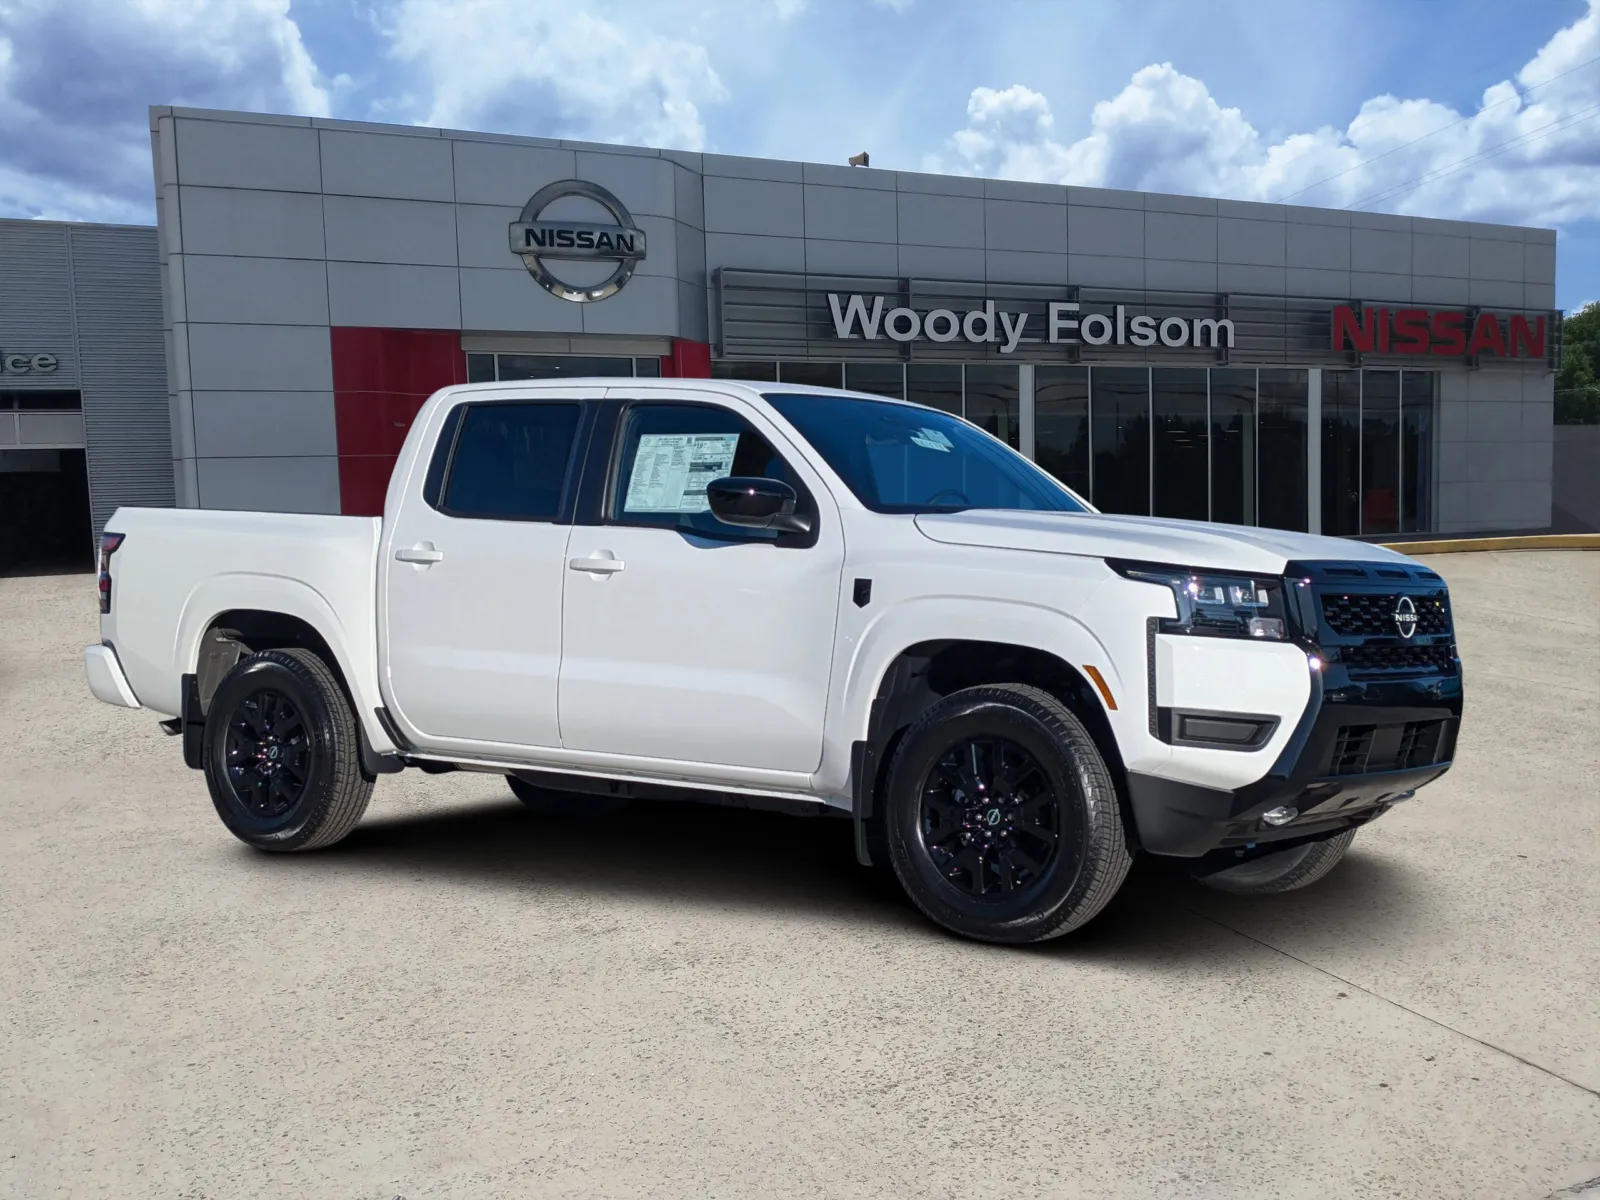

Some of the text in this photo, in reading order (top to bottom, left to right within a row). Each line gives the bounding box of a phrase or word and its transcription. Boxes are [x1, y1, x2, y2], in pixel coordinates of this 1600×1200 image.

[524, 228, 635, 252] NISSAN
[827, 293, 1236, 354] Woody Folsom
[1333, 305, 1546, 358] NISSAN
[0, 353, 57, 373] ce
